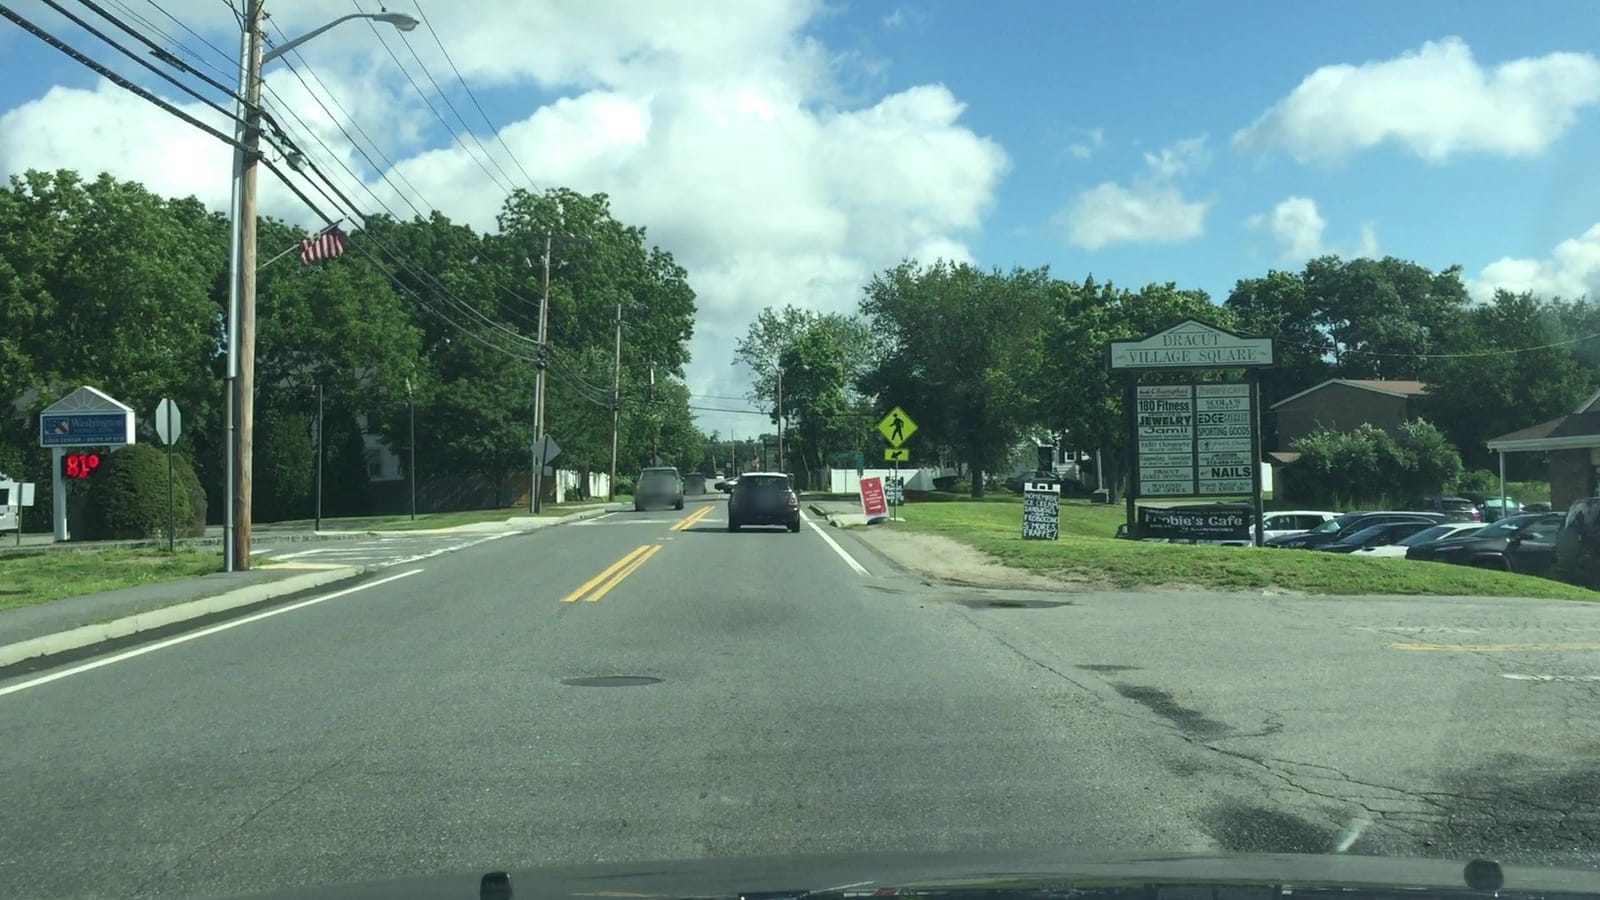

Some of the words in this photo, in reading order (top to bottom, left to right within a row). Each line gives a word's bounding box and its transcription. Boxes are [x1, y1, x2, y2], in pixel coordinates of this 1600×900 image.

[1163, 334, 1220, 347] DRACUT
[1129, 351, 1191, 363] VILLAGE
[1199, 350, 1257, 363] SQUARE
[1139, 400, 1155, 411] 180
[1157, 400, 1190, 411] Fitness
[71, 416, 123, 429] Washington
[1139, 415, 1191, 425] JEWELRY
[1198, 413, 1224, 423] EDGE
[1198, 426, 1227, 437] SPORTING
[1229, 426, 1250, 436] GOODS
[1211, 467, 1251, 478] NAILS
[1208, 515, 1243, 526] Cafe
